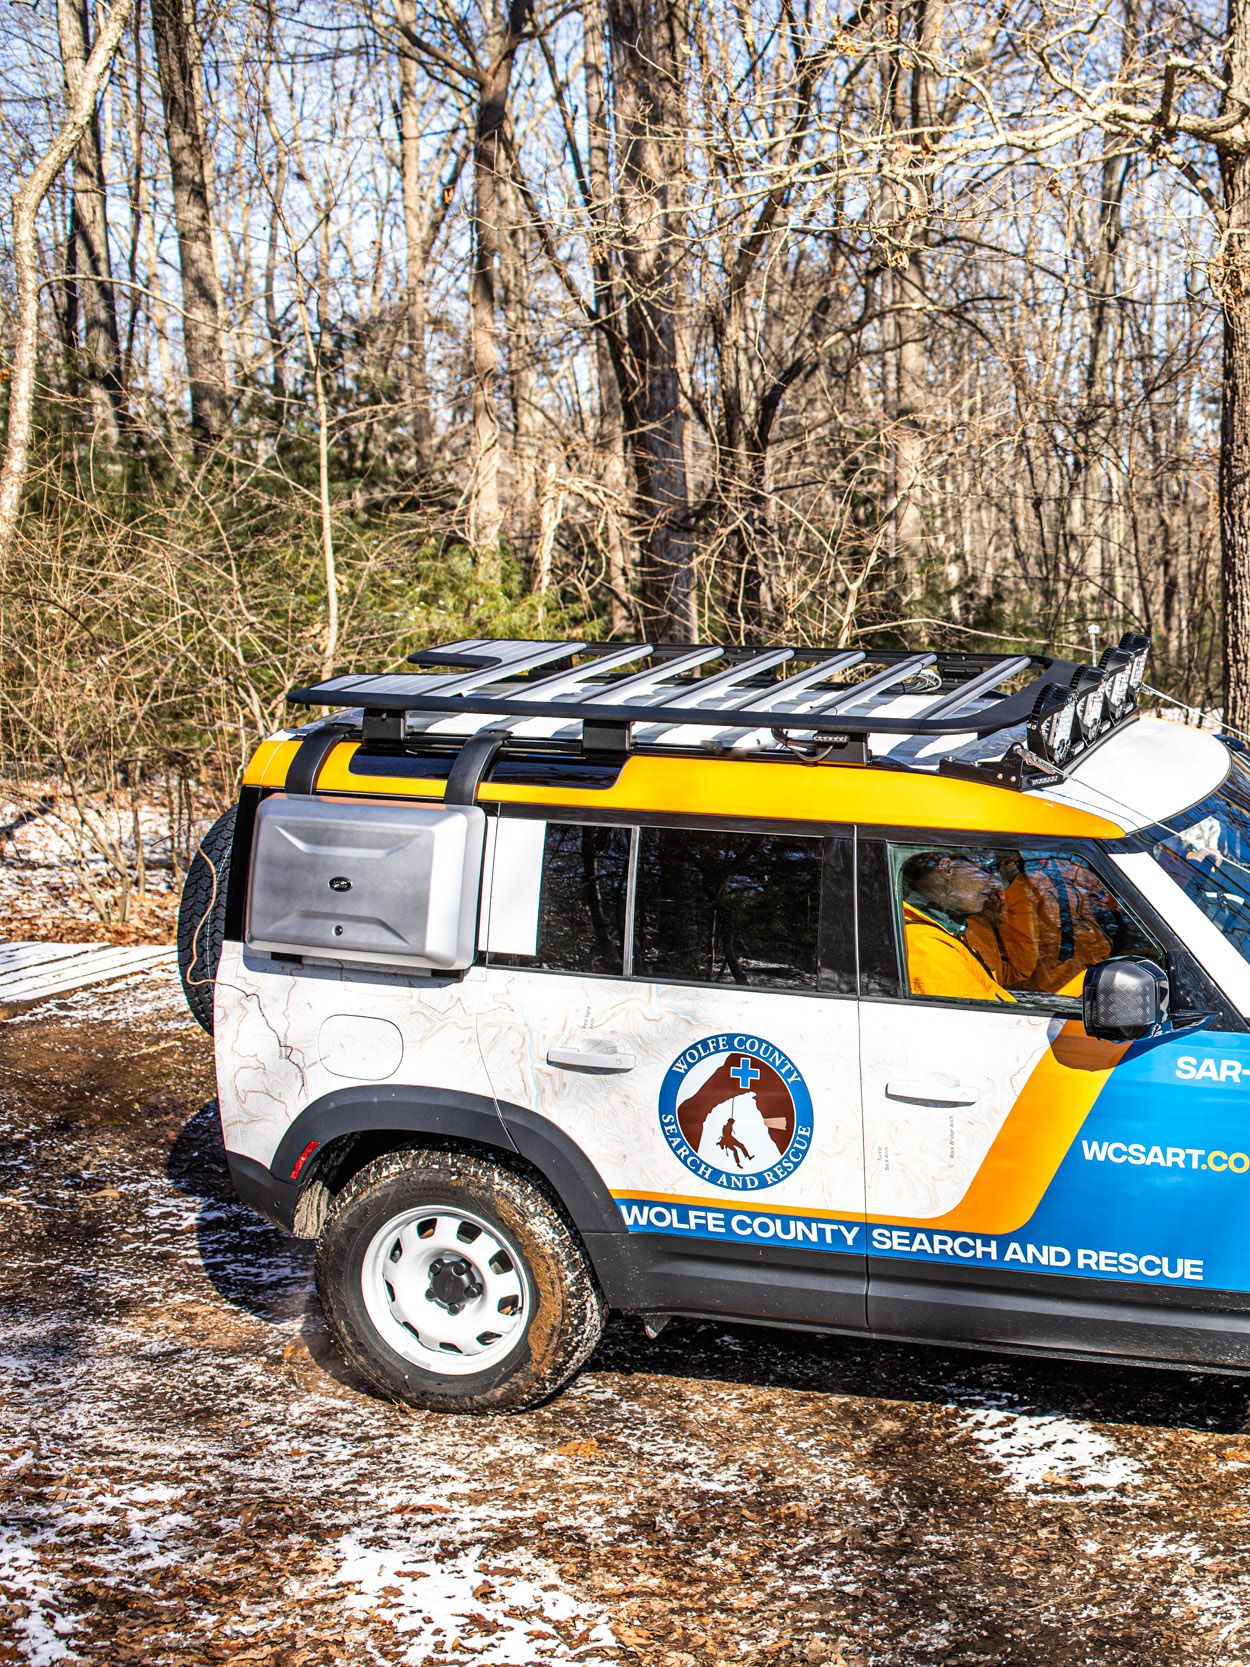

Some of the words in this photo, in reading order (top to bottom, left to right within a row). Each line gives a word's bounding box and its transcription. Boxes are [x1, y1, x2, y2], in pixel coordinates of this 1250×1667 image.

[672, 1036, 729, 1075] WOLFE
[734, 1036, 801, 1085] COUNTY
[661, 1113, 712, 1179] SEARCH
[717, 1174, 759, 1189] AND
[763, 1125, 811, 1185] RESCUE
[619, 1205, 725, 1233] WOLFE
[730, 1214, 860, 1246] COUNTY
[872, 1228, 998, 1261] SEARCH
[1004, 1242, 1071, 1268] AND
[1077, 1249, 1204, 1281] RESCUE
